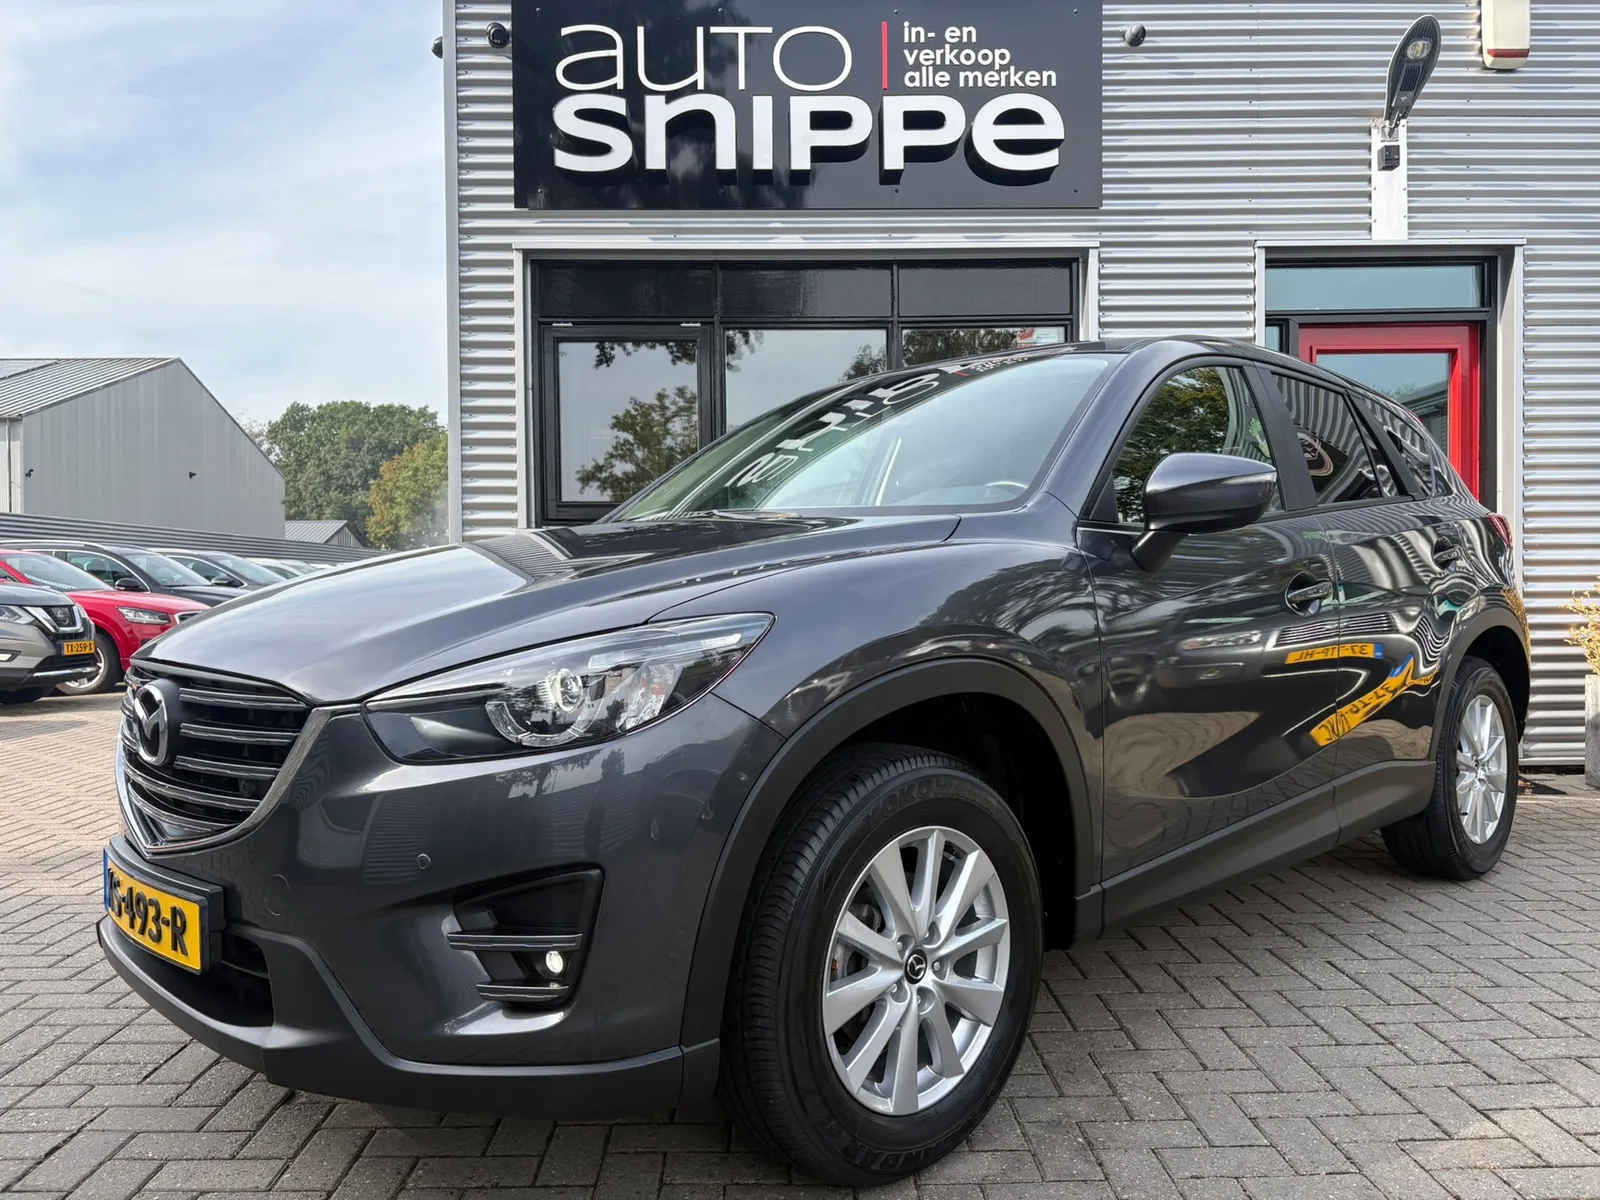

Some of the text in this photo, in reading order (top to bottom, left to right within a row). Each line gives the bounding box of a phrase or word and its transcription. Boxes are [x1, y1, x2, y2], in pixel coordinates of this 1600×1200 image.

[903, 21, 977, 43] in- en
[903, 44, 1011, 70] verkoop
[904, 66, 1057, 88] alle merken
